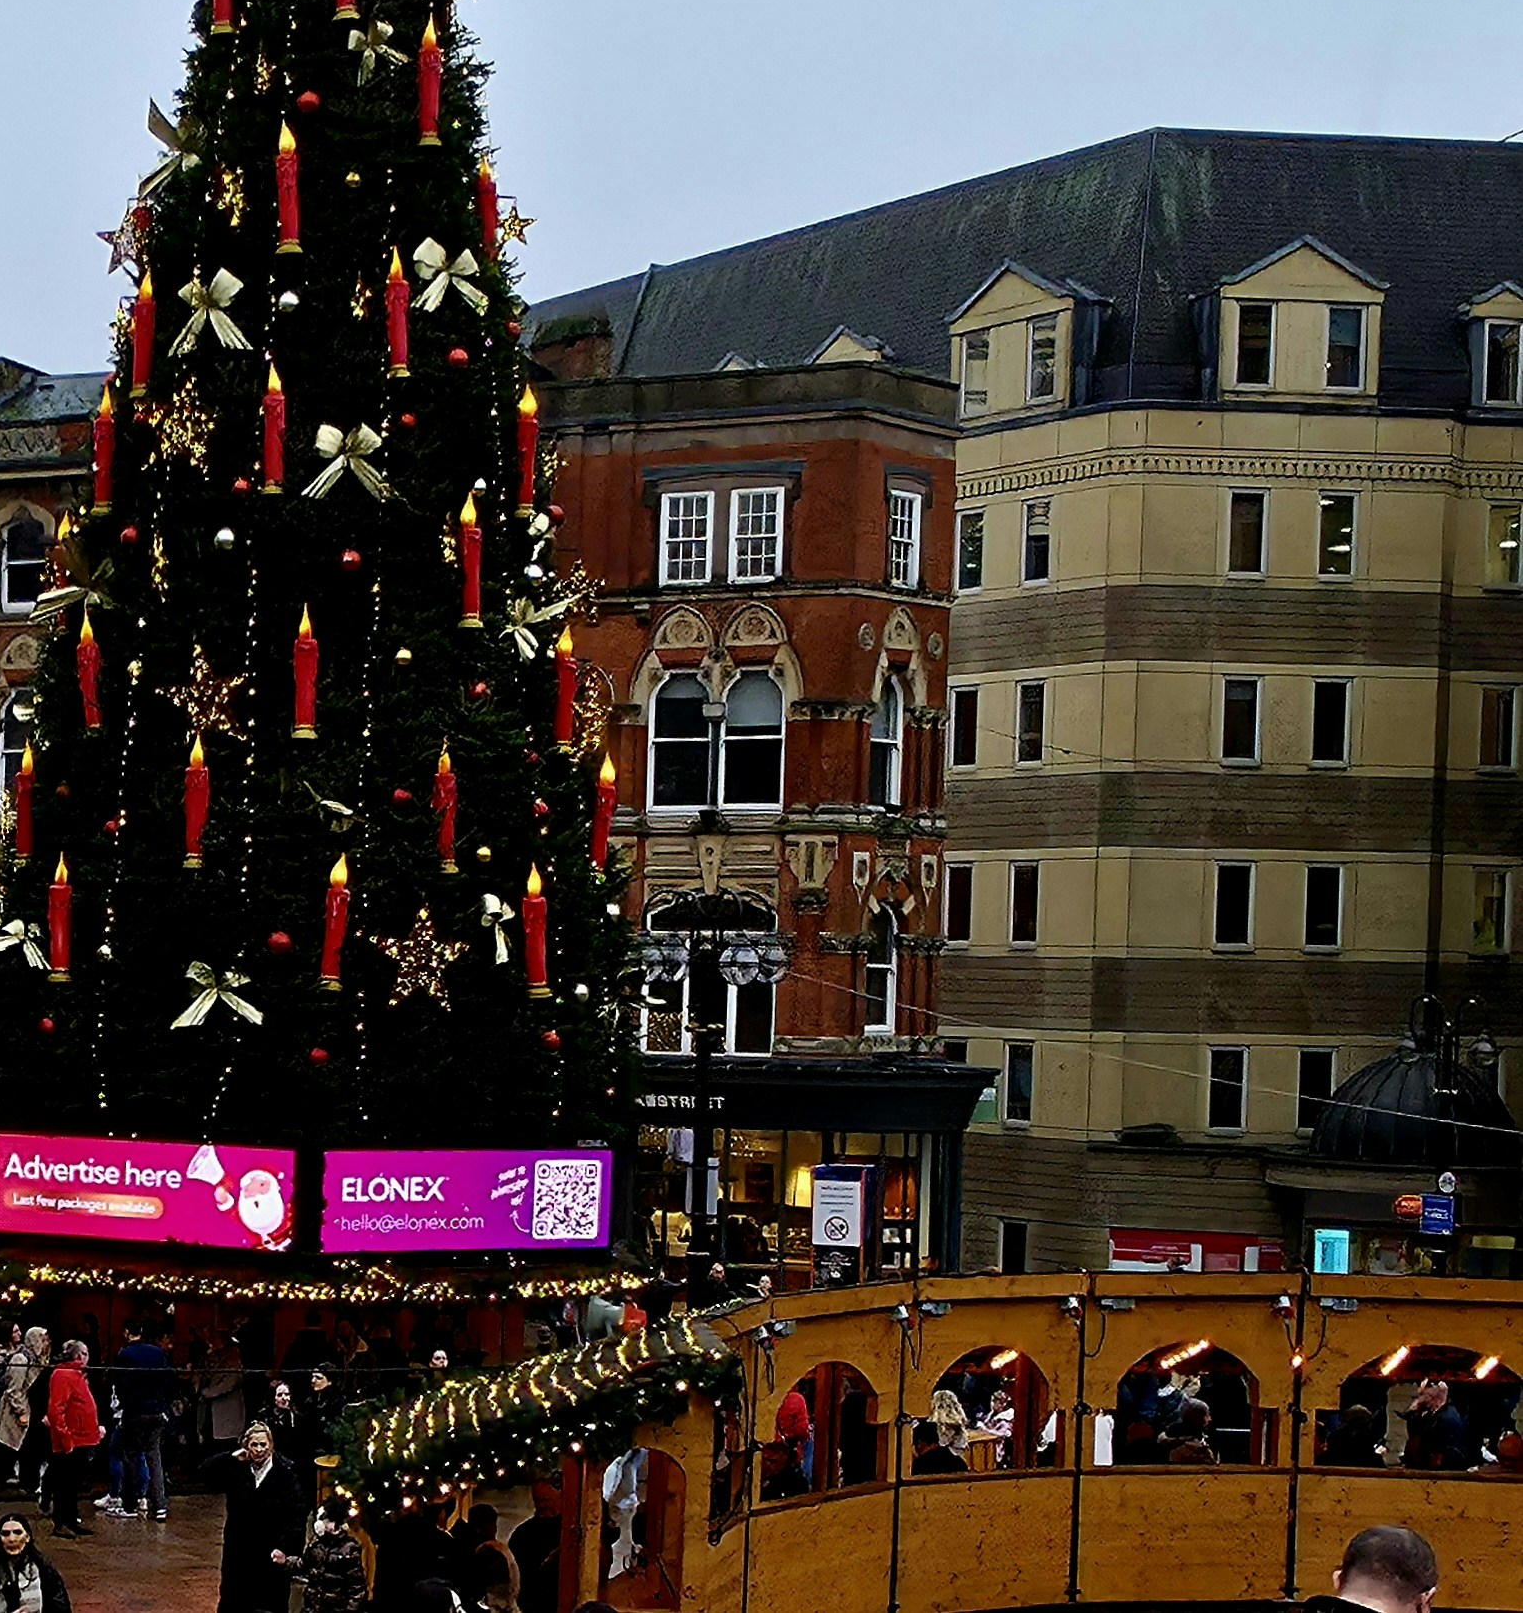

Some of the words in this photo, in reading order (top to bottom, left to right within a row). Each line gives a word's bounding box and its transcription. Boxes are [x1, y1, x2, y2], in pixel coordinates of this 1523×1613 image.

[4, 1153, 120, 1185] Advertise
[125, 1160, 182, 1189] here
[341, 1176, 446, 1203] ELONEX
[340, 1214, 485, 1234] hello@elonex.com
